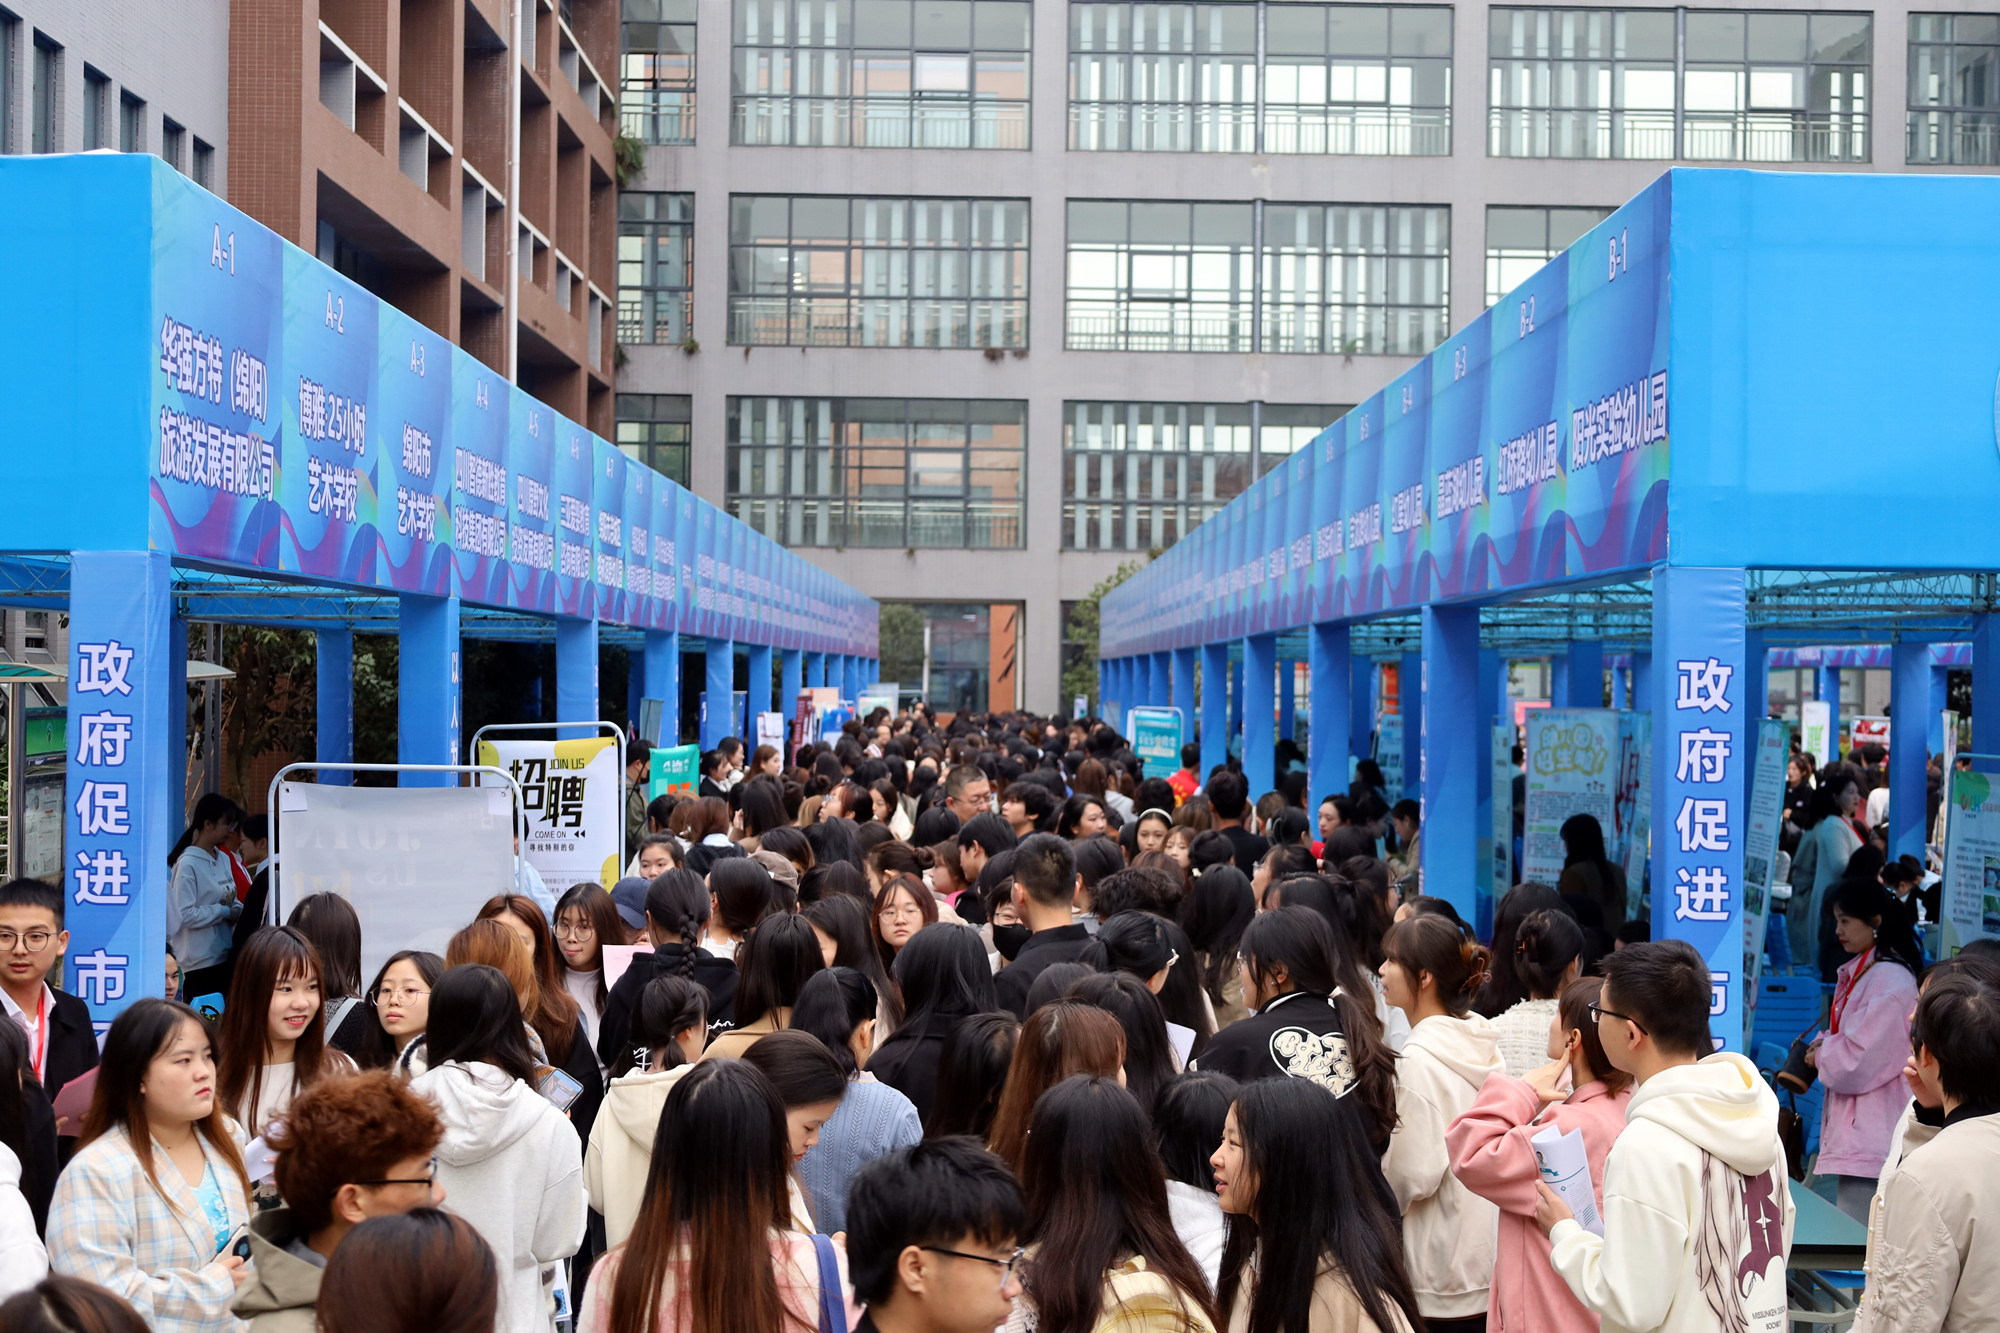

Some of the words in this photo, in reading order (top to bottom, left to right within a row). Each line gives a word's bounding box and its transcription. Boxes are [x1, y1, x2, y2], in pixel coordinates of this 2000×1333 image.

[211, 223, 235, 276] A-1
[1608, 227, 1628, 282] B-1
[325, 291, 344, 335] A-2
[1519, 295, 1535, 339] B-2
[410, 340, 425, 378] A-3
[1454, 345, 1467, 382] B-3
[476, 379, 489, 411] A-4
[1402, 383, 1413, 415] B-4
[1571, 369, 1668, 471] 阳光实验幼儿园
[159, 408, 275, 501] 旅游发展有限公司
[403, 422, 432, 479] 绵阳市
[308, 457, 358, 523] 艺术学校
[397, 485, 436, 543] 艺术学校
[454, 504, 507, 561] 科技集团有限公司
[74, 640, 134, 906] 政府促进
[549, 758, 569, 770] JOIN
[571, 758, 585, 769] US
[1674, 657, 1733, 922] 政府促进
[509, 758, 588, 828] 招聘
[534, 830, 555, 839] COME
[556, 830, 567, 839] ON
